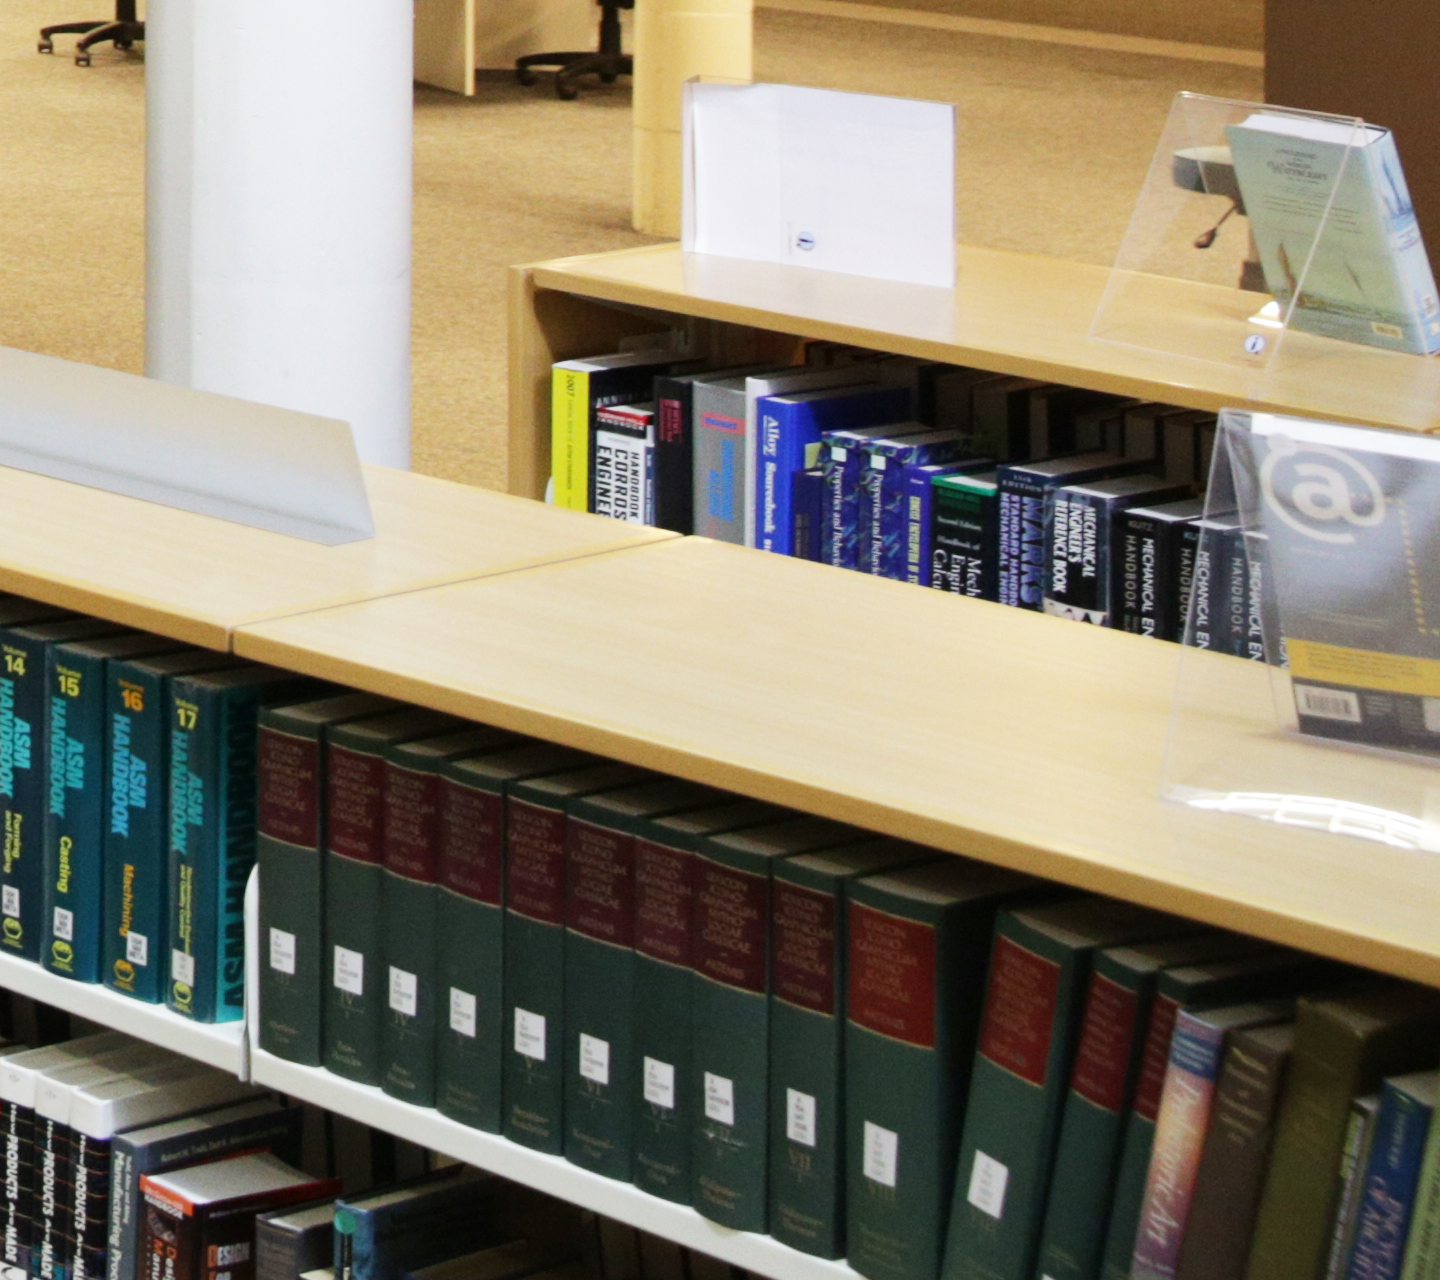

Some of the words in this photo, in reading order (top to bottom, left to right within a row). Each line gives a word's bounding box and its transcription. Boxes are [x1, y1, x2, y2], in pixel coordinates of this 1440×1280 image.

[763, 415, 779, 457] Alloy
[629, 451, 641, 519] HANDBOOK
[764, 461, 778, 533] Sourcebook
[832, 465, 844, 511] Properties
[871, 474, 884, 518] Properties
[832, 513, 843, 531] and
[871, 520, 882, 539] and
[999, 492, 1010, 566] MECHANICAL
[1010, 494, 1021, 556] STANDARD
[1053, 499, 1068, 557] REFERENCE
[1082, 505, 1097, 577] MECHANICAL
[1052, 558, 1068, 594] BOOK
[1124, 535, 1137, 609] HANDBOOK
[1141, 538, 1155, 612] MECHANICAL
[1179, 547, 1193, 622] HANDBOOK
[1196, 550, 1210, 626] MECHANICAL
[1231, 557, 1244, 633] HANDBOOK
[1248, 560, 1262, 637] MECHANICAL
[4, 654, 26, 676] 14
[58, 675, 79, 697] 15
[121, 690, 144, 712] 16
[177, 708, 198, 730] 17
[13, 716, 31, 770] ASM
[49, 696, 66, 820] HANDBOOK
[65, 736, 84, 789] ASM
[111, 713, 131, 838] HANDBOOK
[128, 754, 147, 809] ASM
[171, 730, 188, 856] HANDBOOK
[186, 769, 203, 826] ASM
[57, 836, 72, 893] Casting
[119, 864, 134, 937] Machining
[6, 1133, 18, 1199] PRODUCTS
[43, 1150, 55, 1216] PRODUCTS
[74, 1164, 87, 1231] PRODUCTS
[108, 1150, 126, 1247] Manufacturing
[5, 1224, 17, 1262] MADE
[41, 1241, 53, 1279] MADE
